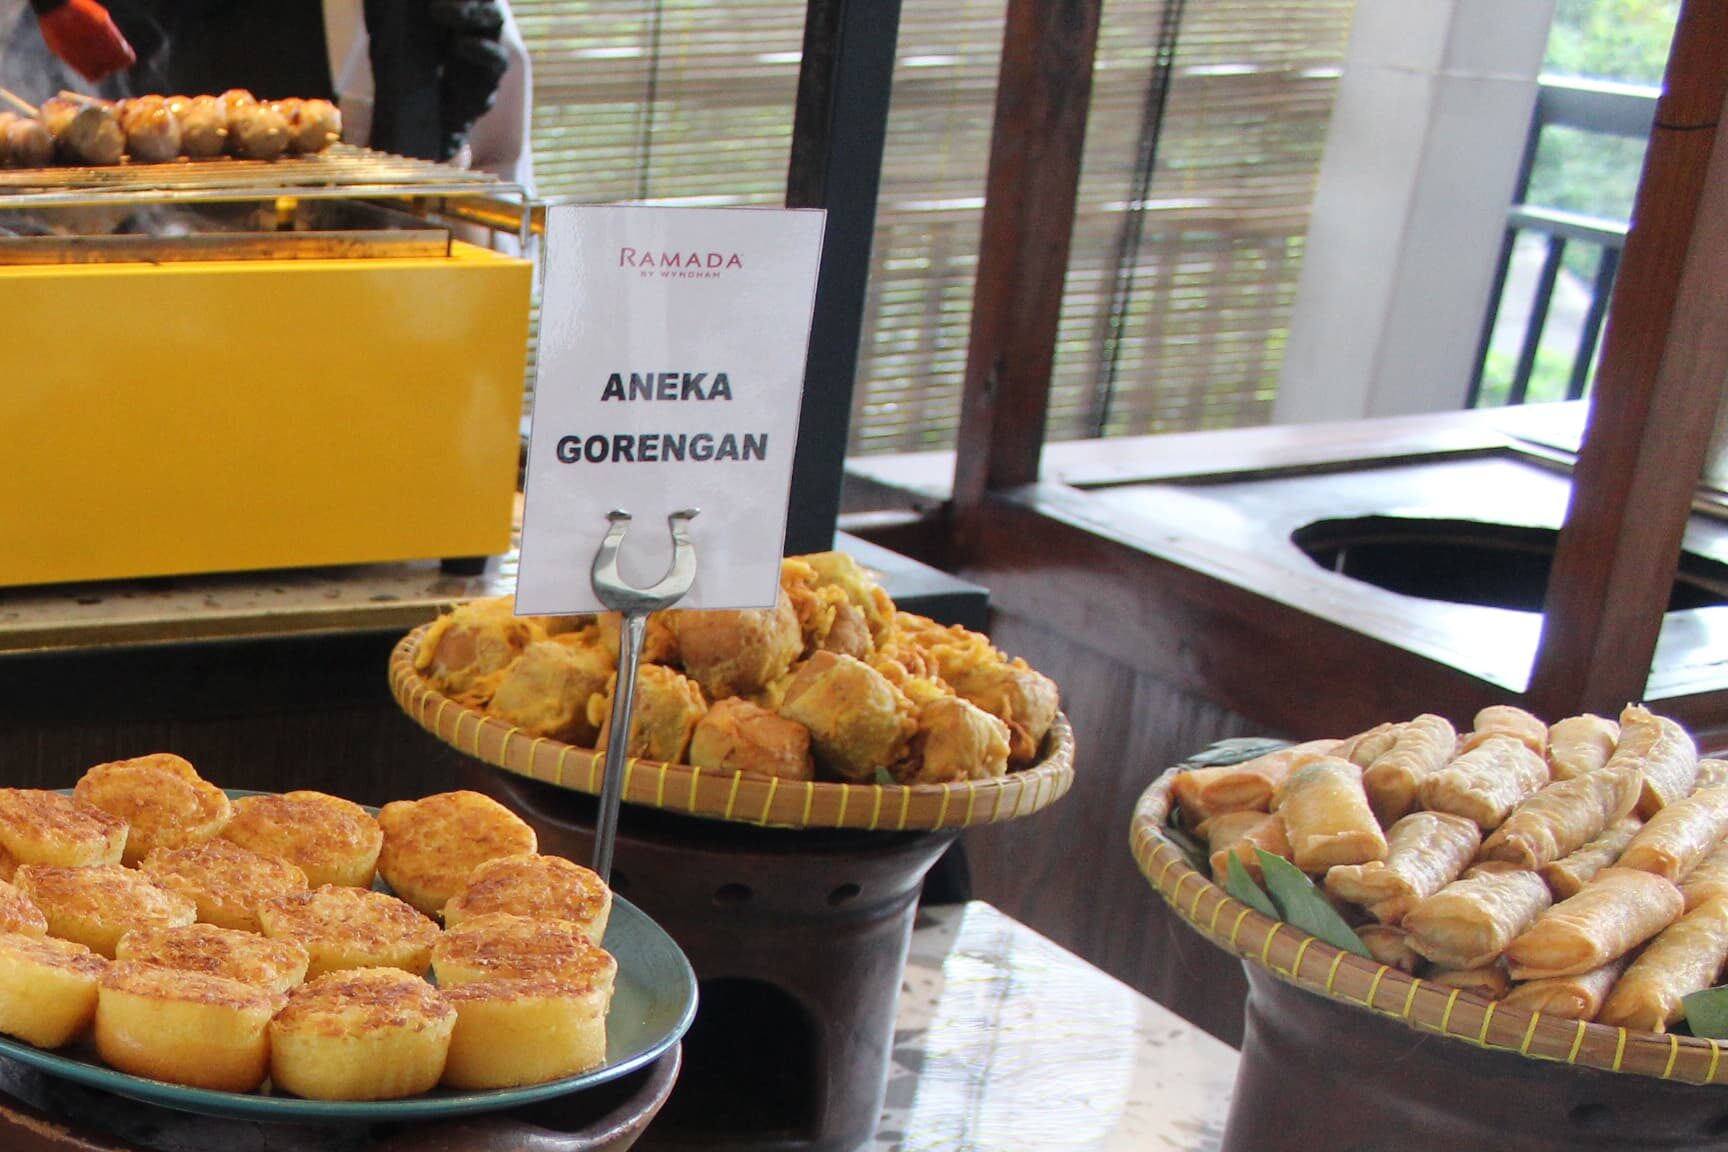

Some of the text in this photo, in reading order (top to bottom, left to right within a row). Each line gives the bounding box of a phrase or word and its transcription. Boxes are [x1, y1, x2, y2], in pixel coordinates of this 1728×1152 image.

[619, 247, 743, 269] RAMADA
[640, 271, 721, 279] BY WYNDHAM
[600, 373, 732, 401] ANEKA
[556, 433, 769, 464] GORENGAN
